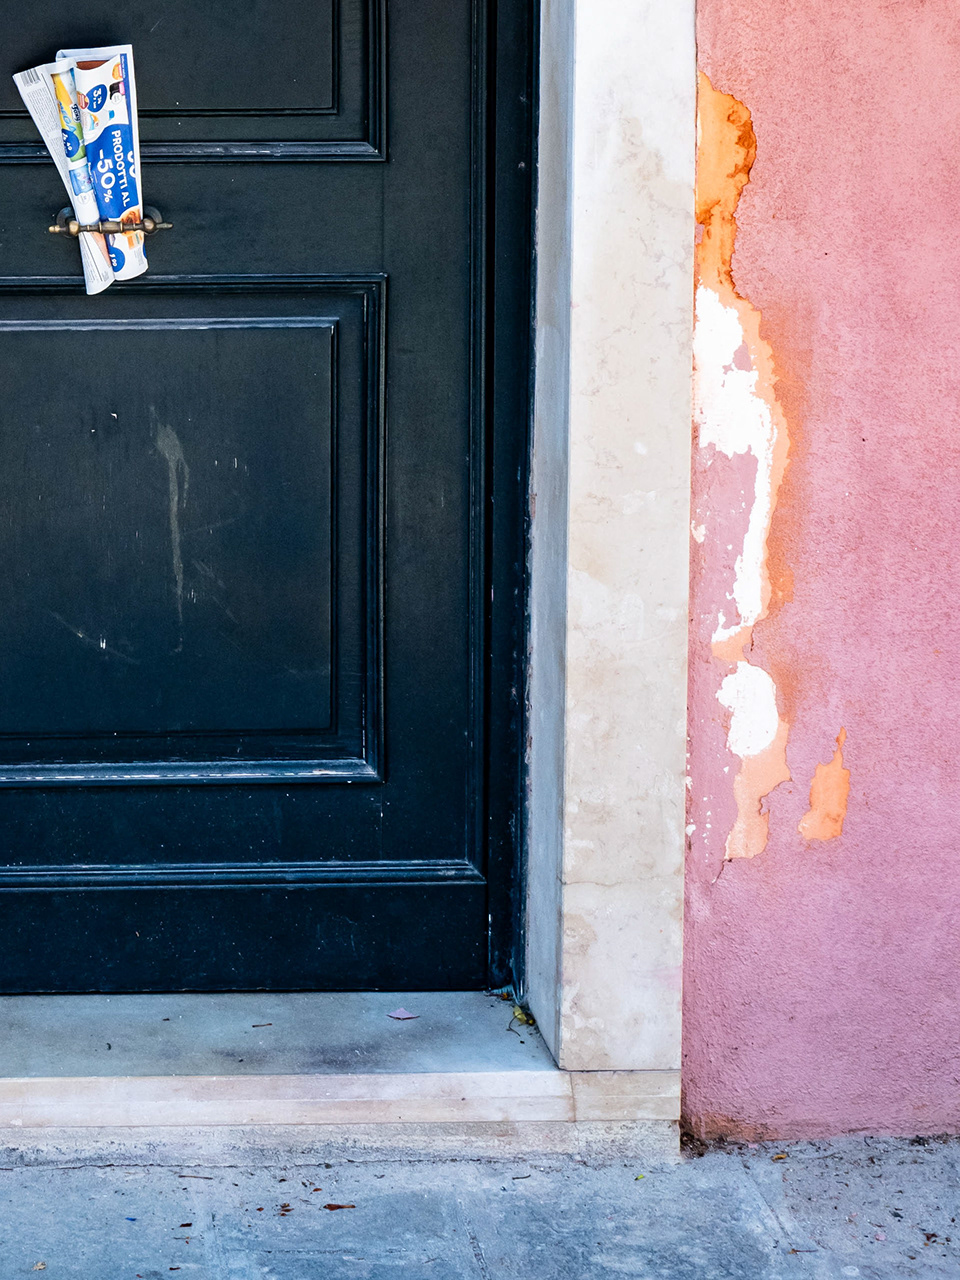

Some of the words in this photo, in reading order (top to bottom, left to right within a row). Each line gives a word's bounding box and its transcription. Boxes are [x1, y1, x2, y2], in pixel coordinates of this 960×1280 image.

[97, 148, 116, 203] -50%
[111, 129, 129, 190] PRODOTTI
[121, 191, 131, 207] AL
